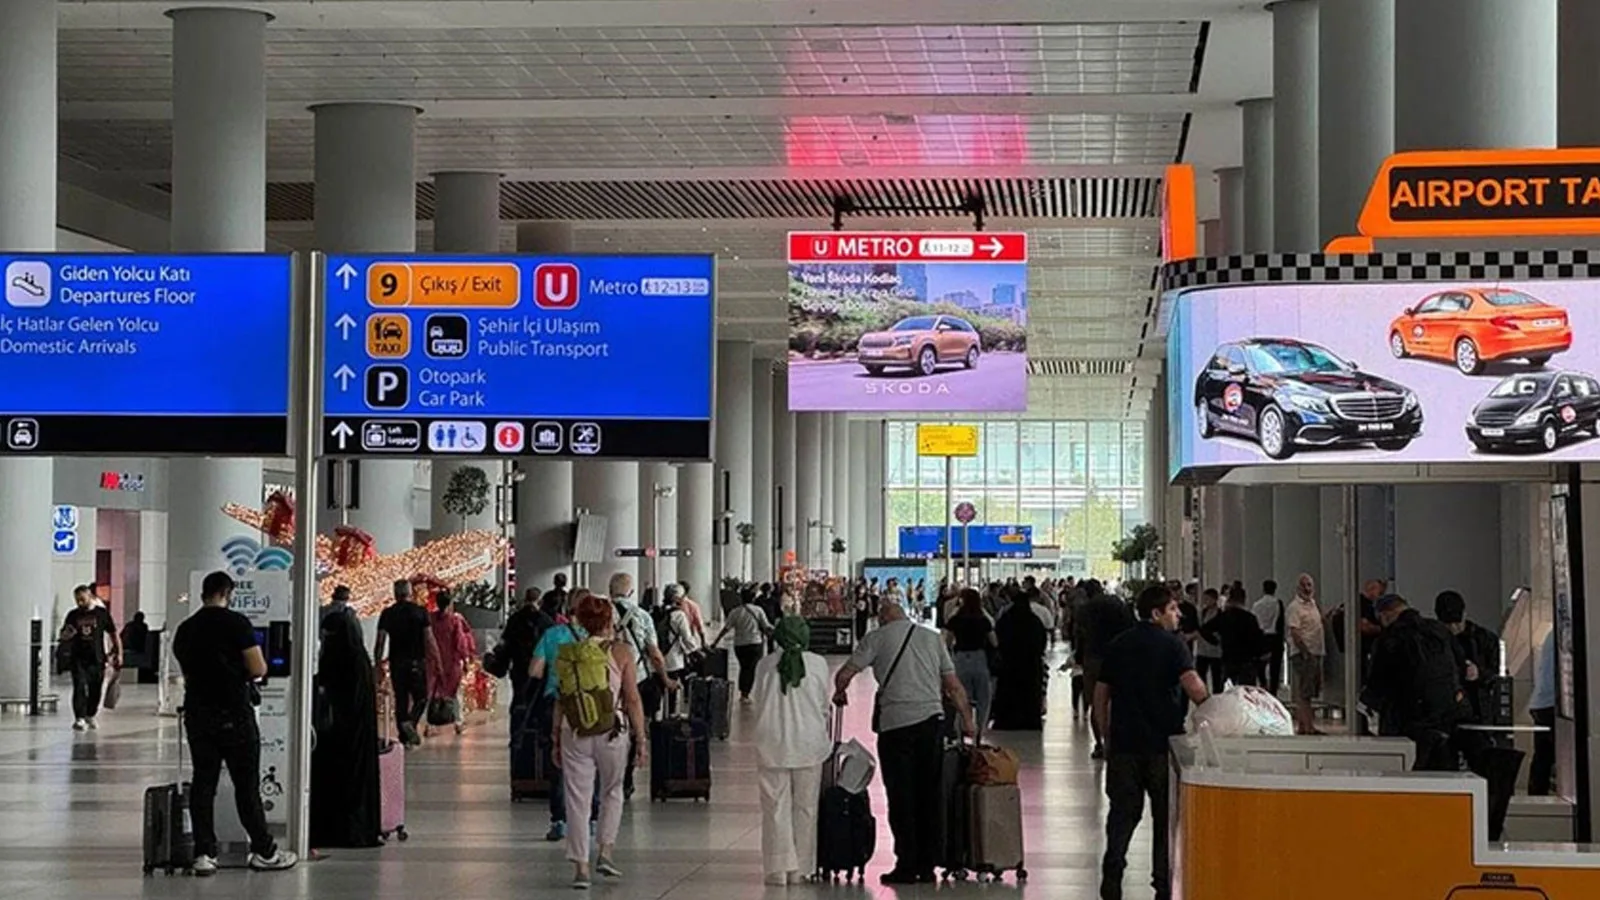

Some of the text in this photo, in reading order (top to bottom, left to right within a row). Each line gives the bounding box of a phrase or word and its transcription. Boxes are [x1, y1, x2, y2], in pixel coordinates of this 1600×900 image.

[1391, 178, 1550, 207] AIRPORT
[815, 240, 828, 255] U
[838, 238, 913, 257] METRO
[60, 265, 190, 282] Giden Yolcu Katı
[380, 273, 397, 297] 9
[420, 276, 457, 295] Çıkış
[472, 276, 502, 292] Exit
[545, 273, 568, 302] U
[589, 279, 638, 295] Metro
[654, 281, 692, 294] 12-13
[60, 288, 196, 306] Departures Floor
[18, 316, 64, 332] Hatlar
[68, 316, 114, 332] Gelen
[117, 316, 159, 332] Yolcu
[478, 316, 600, 337] Şehir İçi Ulaşım
[1, 339, 137, 354] Domestic Arrivals
[376, 344, 401, 353] TAXI
[478, 341, 608, 358] Public Transport
[419, 368, 486, 386] Otopark
[379, 372, 398, 402] P
[419, 391, 484, 406] Car Park
[388, 426, 401, 434] Left
